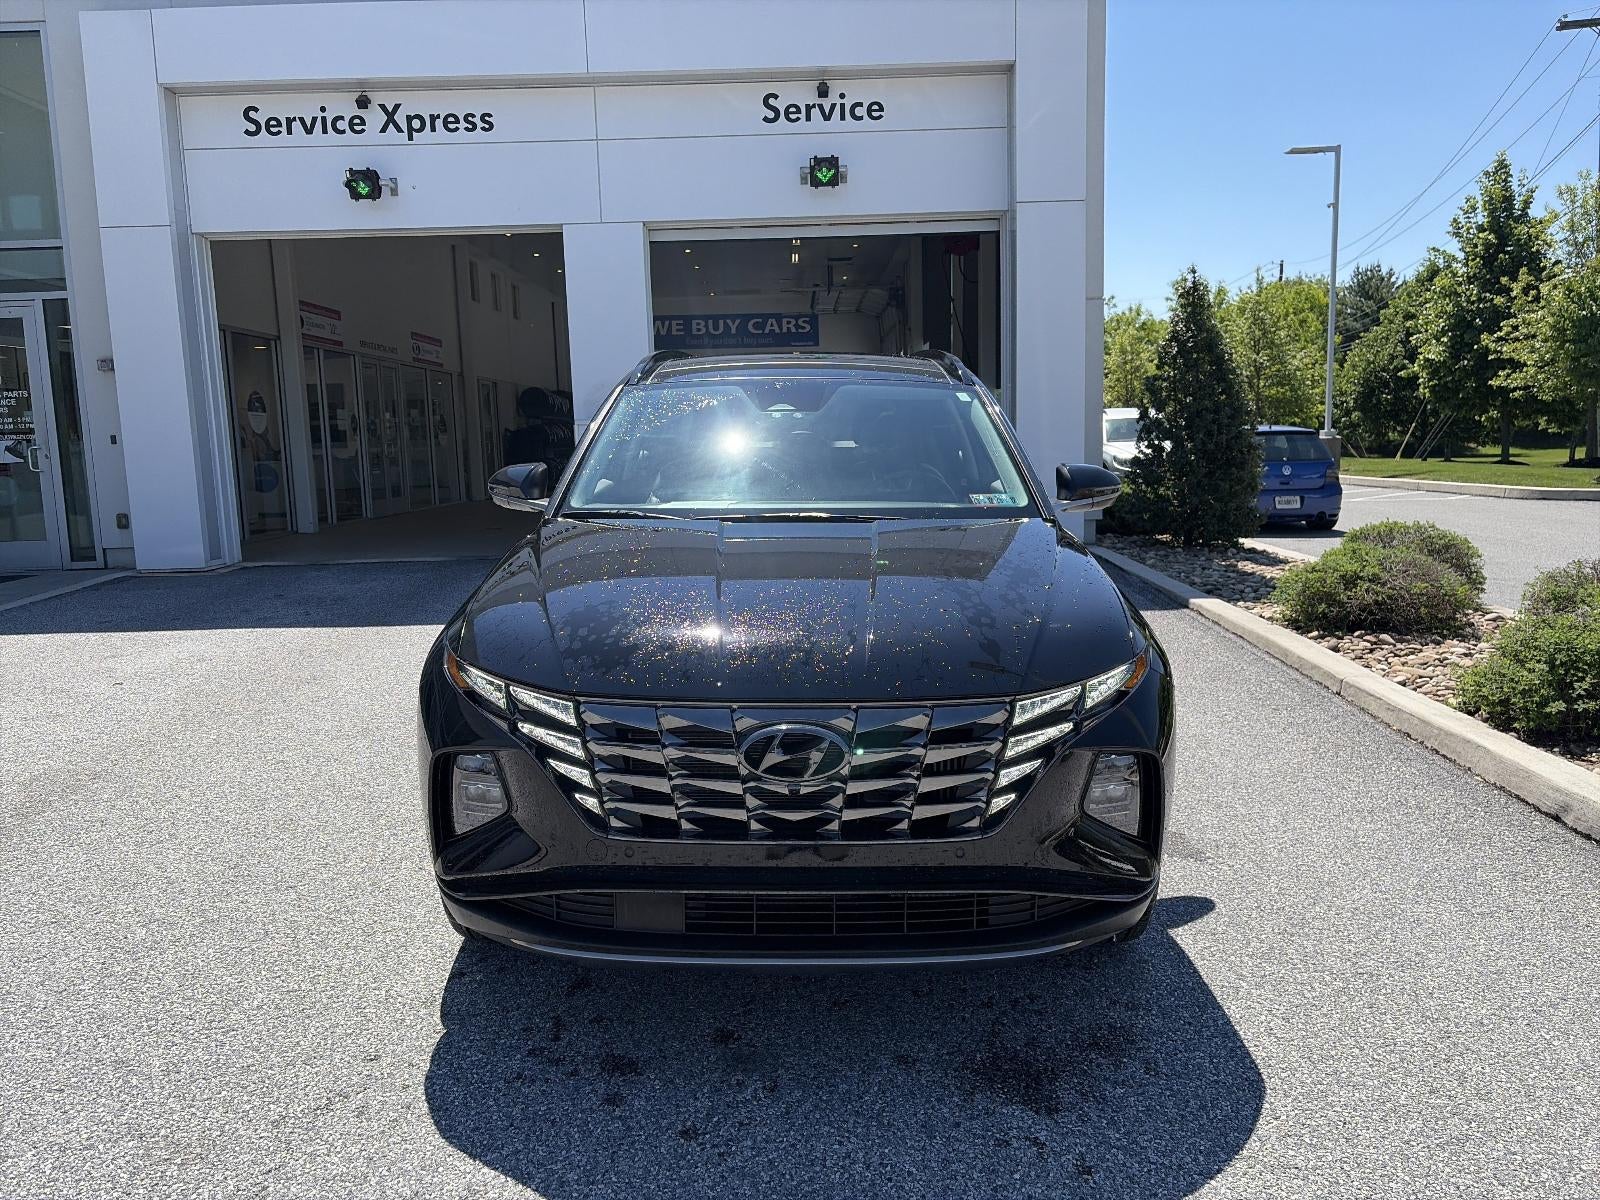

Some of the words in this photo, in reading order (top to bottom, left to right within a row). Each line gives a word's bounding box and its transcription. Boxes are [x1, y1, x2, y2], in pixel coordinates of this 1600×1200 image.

[242, 105, 367, 137] Service
[377, 103, 495, 142] Xpress
[762, 92, 885, 124] Service
[691, 318, 741, 335] BUY
[748, 317, 812, 334] CARS
